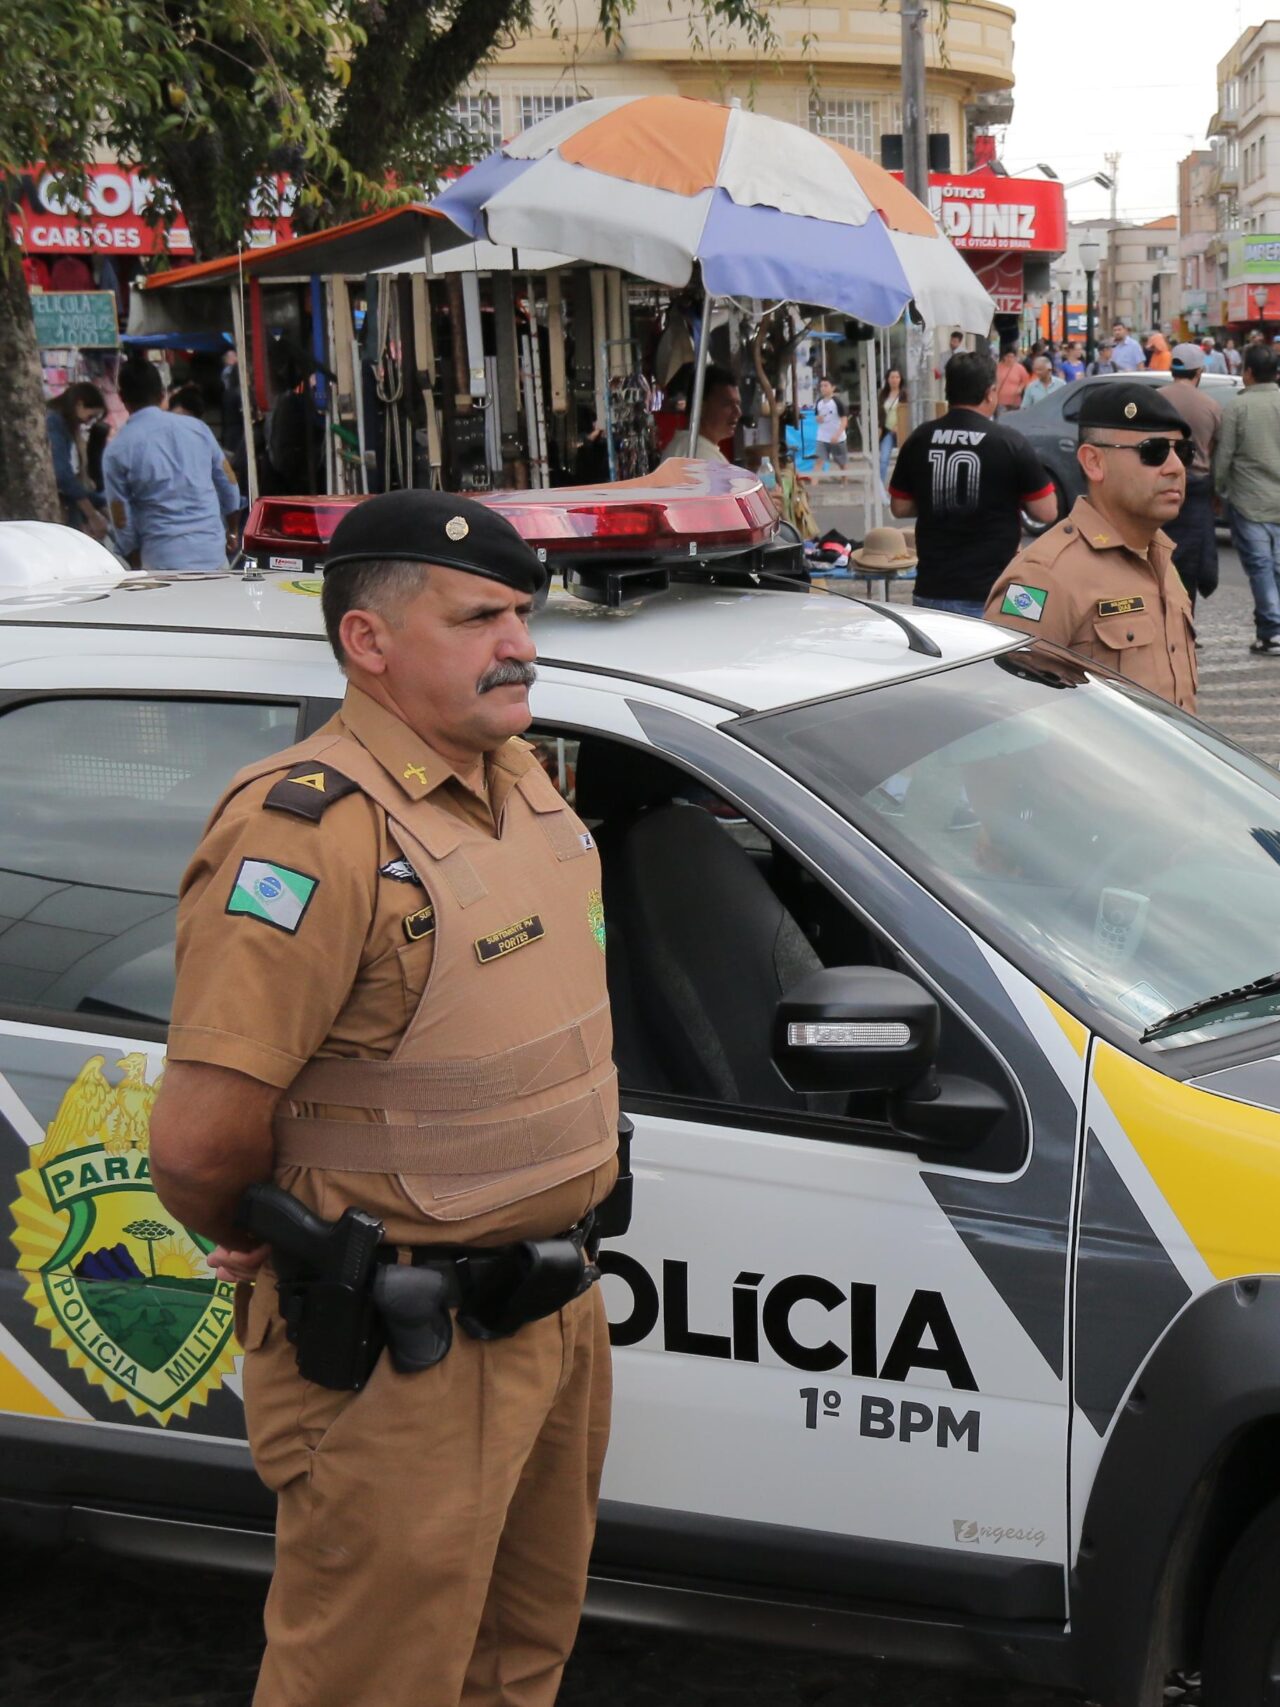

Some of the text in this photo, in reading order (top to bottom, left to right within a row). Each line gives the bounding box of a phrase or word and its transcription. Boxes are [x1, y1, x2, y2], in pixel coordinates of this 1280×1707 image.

[943, 183, 986, 199] ÓTICAS
[31, 223, 140, 248] CARTÕES
[942, 201, 1036, 239] DINIZ
[931, 429, 987, 446] MRV
[928, 449, 981, 513] 10
[498, 930, 530, 953] PORTES
[52, 1157, 151, 1199] PARA
[53, 1276, 236, 1388] POLÍCIA MILITAR
[600, 1250, 980, 1392] OLÍCIA
[799, 1387, 981, 1453] 1º BPM
